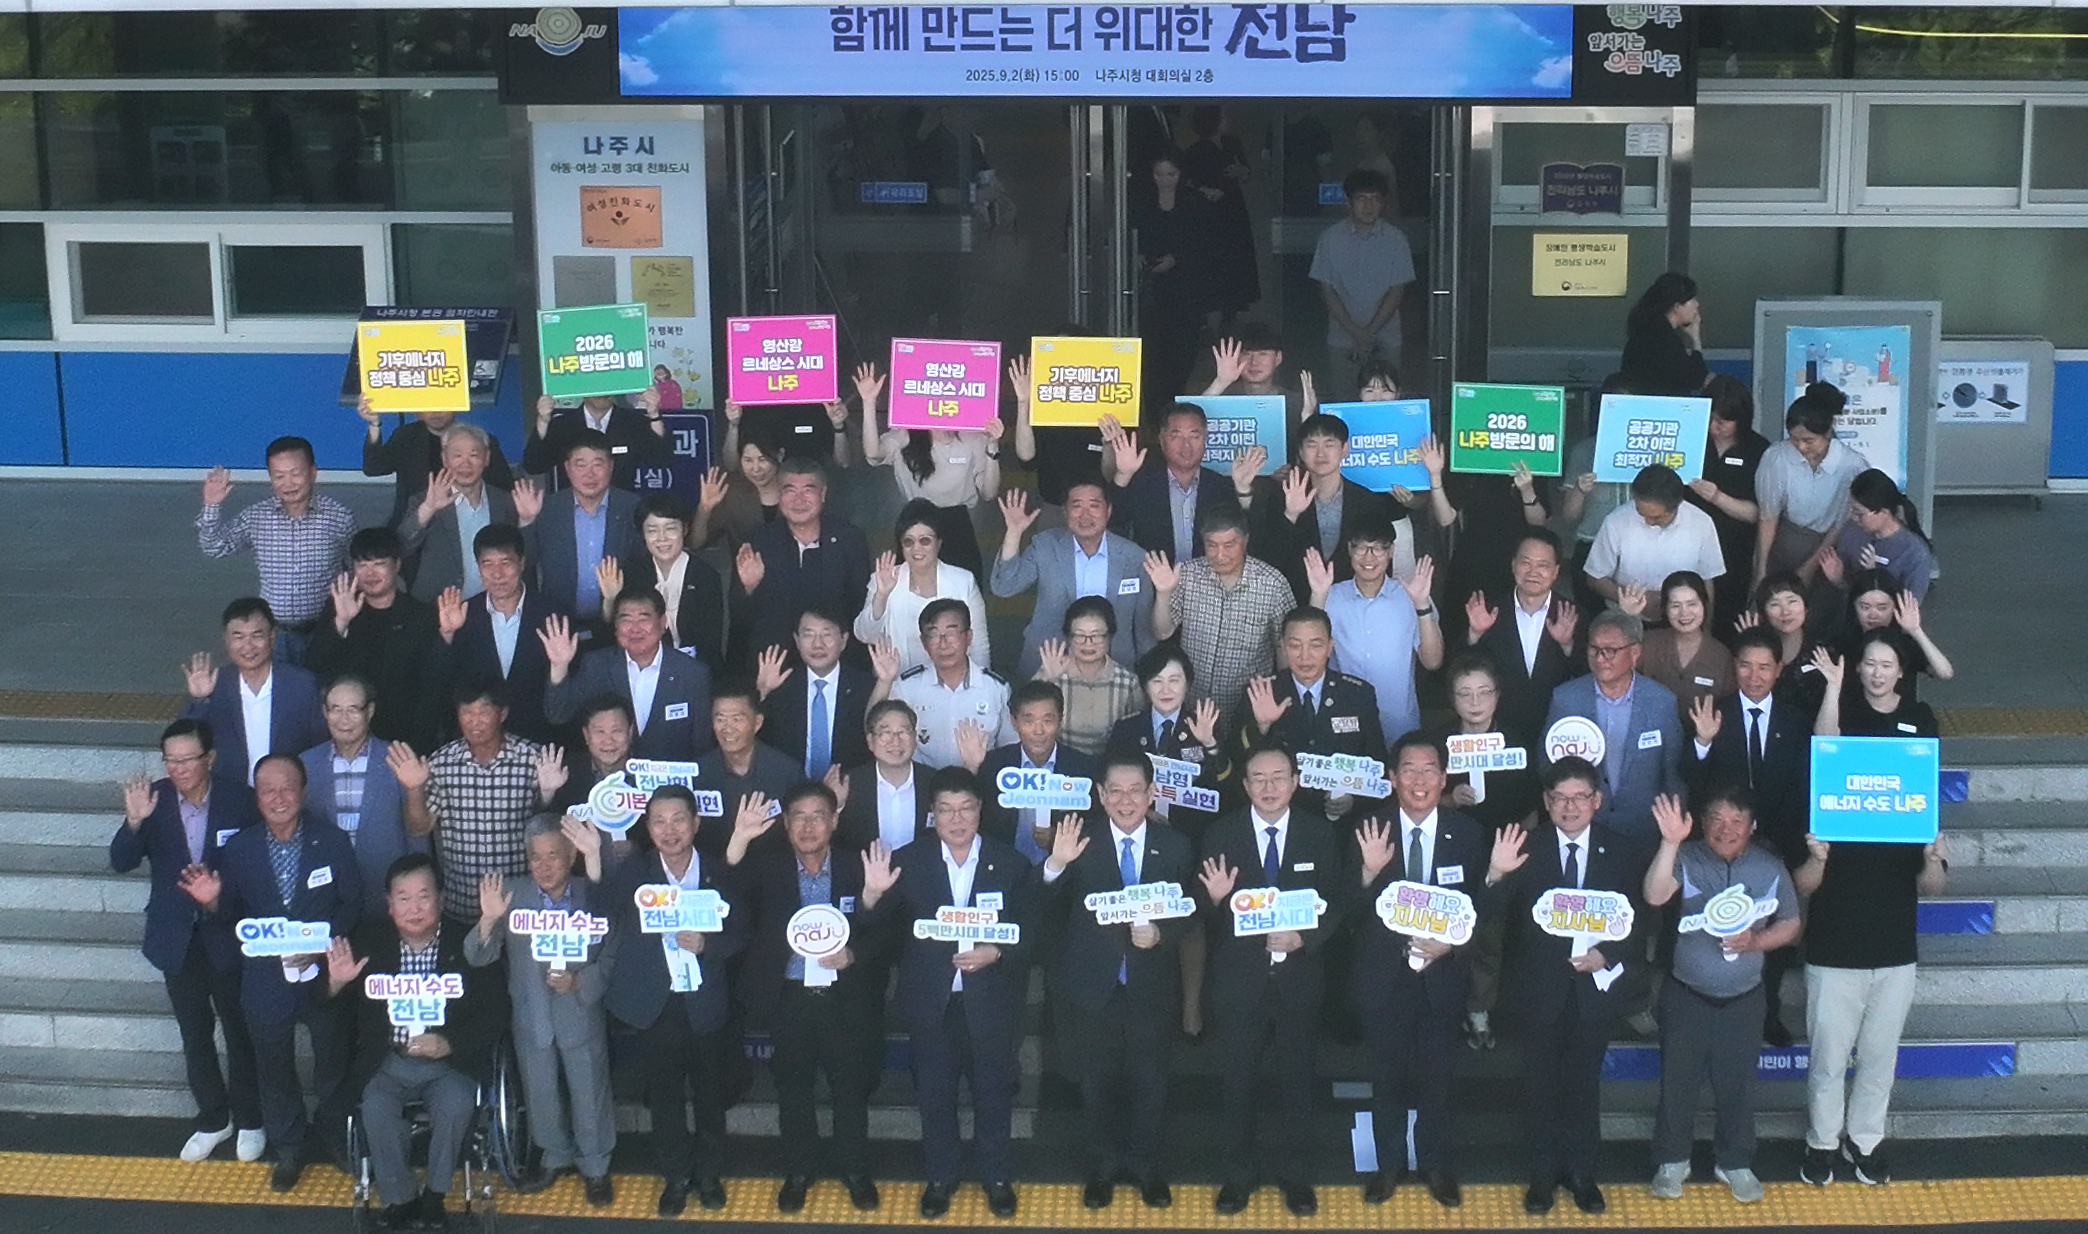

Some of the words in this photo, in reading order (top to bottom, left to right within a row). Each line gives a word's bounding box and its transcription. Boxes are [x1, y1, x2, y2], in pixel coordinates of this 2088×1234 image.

[830, 6, 910, 52] 함께
[922, 6, 1034, 52] 만드는
[1047, 6, 1082, 51] 더
[1094, 5, 1213, 52] 위대한
[1224, 4, 1356, 63] 전남
[1588, 32, 1646, 51] 앞서가는
[966, 69, 1039, 83] 2025.9.2(화)
[1044, 69, 1080, 82] 15:00
[1096, 69, 1141, 83] 나주시청
[1146, 69, 1191, 83] 대회의실
[1196, 69, 1214, 83] 2층
[584, 136, 654, 155] 나주시
[601, 163, 622, 174] 고령
[626, 163, 643, 174] 3대
[647, 163, 689, 174] 친화도시
[658, 326, 684, 335] 행복한
[575, 334, 615, 351] 2026
[762, 338, 803, 353] 영산강
[378, 351, 446, 367] 기후에너지
[549, 352, 625, 374] 나주방문의
[627, 350, 644, 368] 해
[742, 356, 795, 372] 르네상스
[796, 355, 824, 370] 시대
[369, 371, 397, 388] 정책
[398, 371, 426, 387] 중심
[427, 367, 461, 387] 나주
[925, 362, 966, 378] 영산강
[1050, 366, 1119, 383] 기후에너지
[767, 374, 799, 391] 나주
[903, 379, 956, 396] 르네상스
[958, 382, 986, 397] 시대
[1038, 385, 1067, 402] 정책
[1068, 385, 1097, 402] 중심
[1099, 383, 1133, 403] 나주
[928, 400, 959, 417] 나주
[1207, 418, 1258, 432] 공공기관
[1487, 413, 1527, 430] 2026
[1628, 420, 1680, 436] 공공기관
[672, 430, 698, 457] 과
[1208, 434, 1229, 446] 2차
[1230, 433, 1256, 446] 이전
[1351, 434, 1399, 449] 대한민국
[1459, 431, 1536, 450] 나주방문의
[1538, 434, 1555, 451] 해
[1627, 436, 1649, 450] 2차
[1650, 437, 1676, 451] 이전
[1340, 453, 1366, 467] 너지
[1367, 451, 1392, 466] 수도
[1394, 448, 1420, 466] 나주
[1614, 452, 1652, 467] 최적지
[1450, 737, 1501, 753] 생활인구
[1551, 735, 1580, 743] now
[628, 761, 650, 773] OK!
[1334, 756, 1357, 773] 행복
[1359, 760, 1381, 777] 나주
[1491, 752, 1523, 767] 달성!
[1001, 772, 1047, 791] OK!
[1049, 778, 1088, 792] Now
[1303, 773, 1338, 788] 앞서가는
[1340, 775, 1365, 790] 으뜸
[1367, 778, 1389, 795] 나주
[1846, 774, 1902, 791] 대한민국
[697, 795, 720, 813] 현
[1002, 793, 1088, 807] Jeonnam
[1182, 789, 1216, 809] 실현
[1820, 794, 1861, 811] 에너지
[1863, 795, 1891, 812] 수도
[1894, 794, 1927, 813] 나주
[639, 888, 678, 907] OK!
[1089, 893, 1126, 907] 살기좋은
[1127, 888, 1151, 902] 행복
[1154, 885, 1179, 899] 나주
[1235, 891, 1275, 911] OK!
[1397, 885, 1462, 916] 환영해요
[1553, 893, 1618, 914] 환영해요
[644, 909, 717, 929] 전남시대
[941, 911, 994, 924] 생활인구
[1100, 909, 1138, 921] 앞서가는
[1140, 902, 1165, 915] 으뜸
[1168, 900, 1194, 913] 나주
[1239, 908, 1314, 931] 전남시대
[1388, 903, 1449, 935] 지사님
[513, 913, 565, 931] 에너지
[793, 922, 823, 932] now
[1547, 909, 1607, 932] 지사님
[241, 923, 285, 939] OK!
[794, 925, 846, 944] naju
[918, 924, 979, 939] 5백만시대
[984, 927, 1016, 940] 달성!
[536, 934, 585, 957] 전남
[369, 978, 420, 995] 에너지
[426, 978, 460, 995] 수도
[392, 999, 441, 1021] 전남
